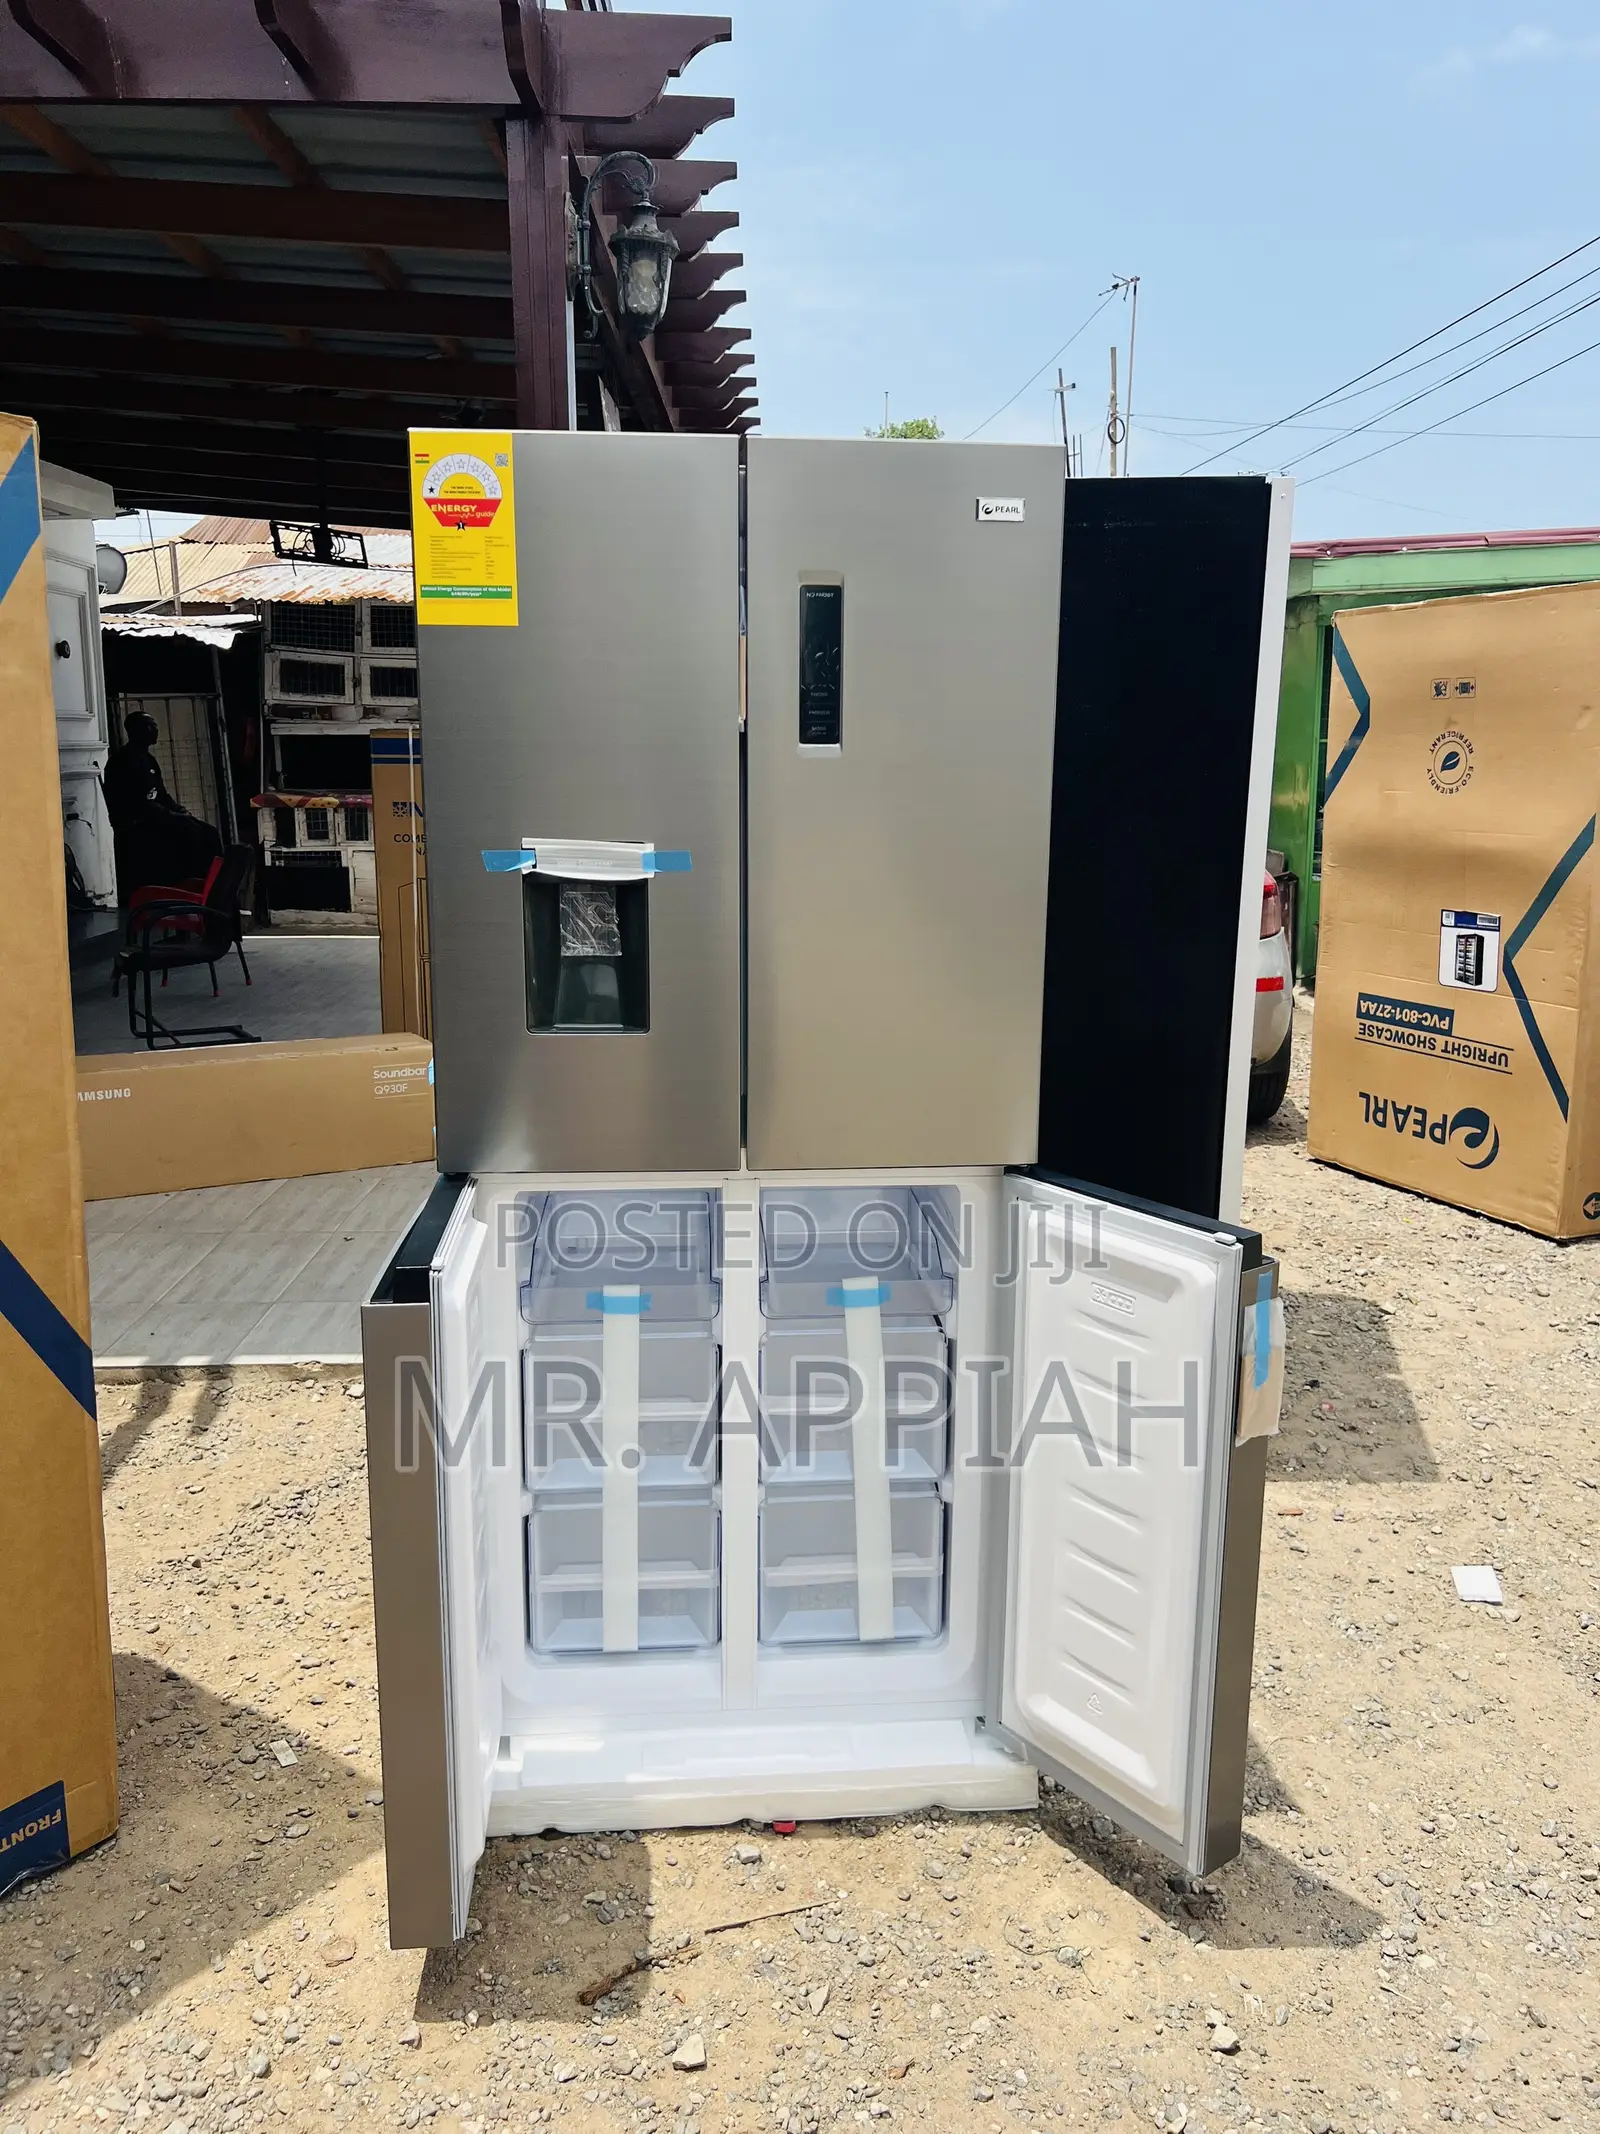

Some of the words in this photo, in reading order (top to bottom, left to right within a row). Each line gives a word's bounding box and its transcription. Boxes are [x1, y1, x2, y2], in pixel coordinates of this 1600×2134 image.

[430, 503, 477, 515] ENERGY
[475, 511, 495, 519] guide
[995, 505, 1021, 514] PEARL
[1428, 730, 1475, 755] REFRIGERANT
[1426, 765, 1475, 795] ECO-FRIENDLY
[1359, 999, 1450, 1031] PVC-801-27AA
[1358, 1022, 1437, 1051] SHOWCASE
[1440, 1040, 1509, 1068] UPRIGHT
[373, 1067, 427, 1079] Soundbar
[374, 1083, 408, 1095] Q930F
[1358, 1091, 1448, 1145] PEARL
